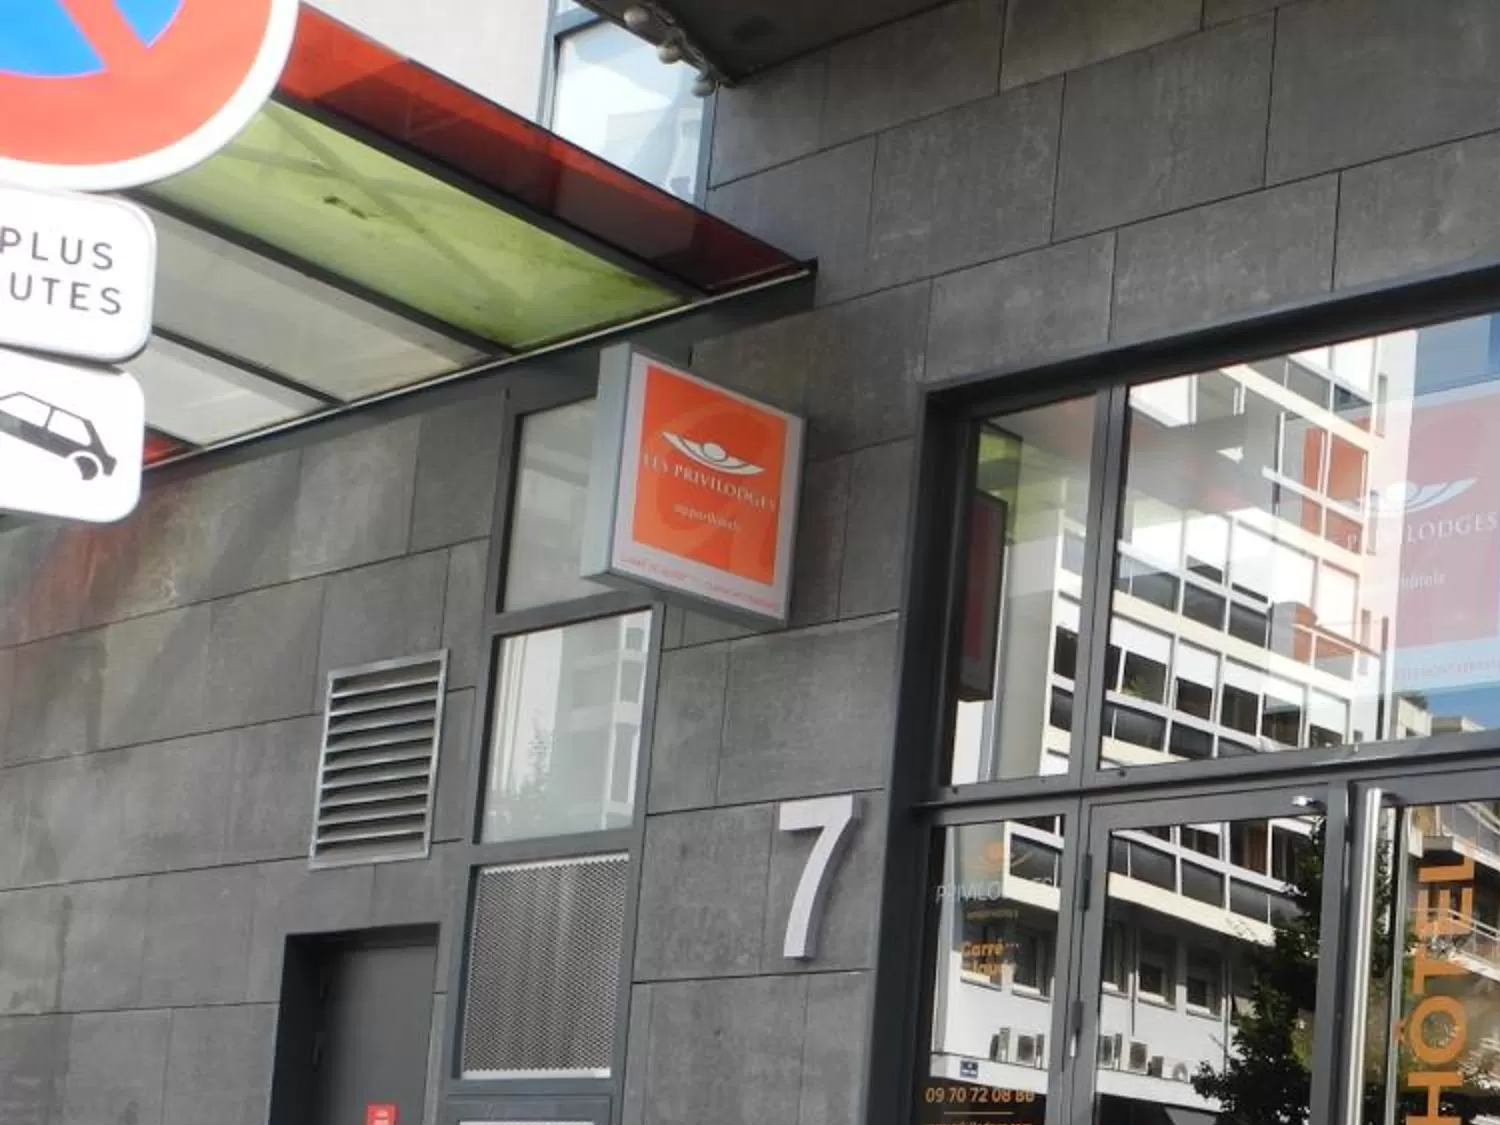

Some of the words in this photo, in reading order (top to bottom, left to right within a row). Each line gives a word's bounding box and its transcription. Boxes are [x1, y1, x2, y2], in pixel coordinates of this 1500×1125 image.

[0, 226, 114, 271] PLUS
[674, 463, 776, 512] PRIVILODGES
[779, 795, 856, 958] 7
